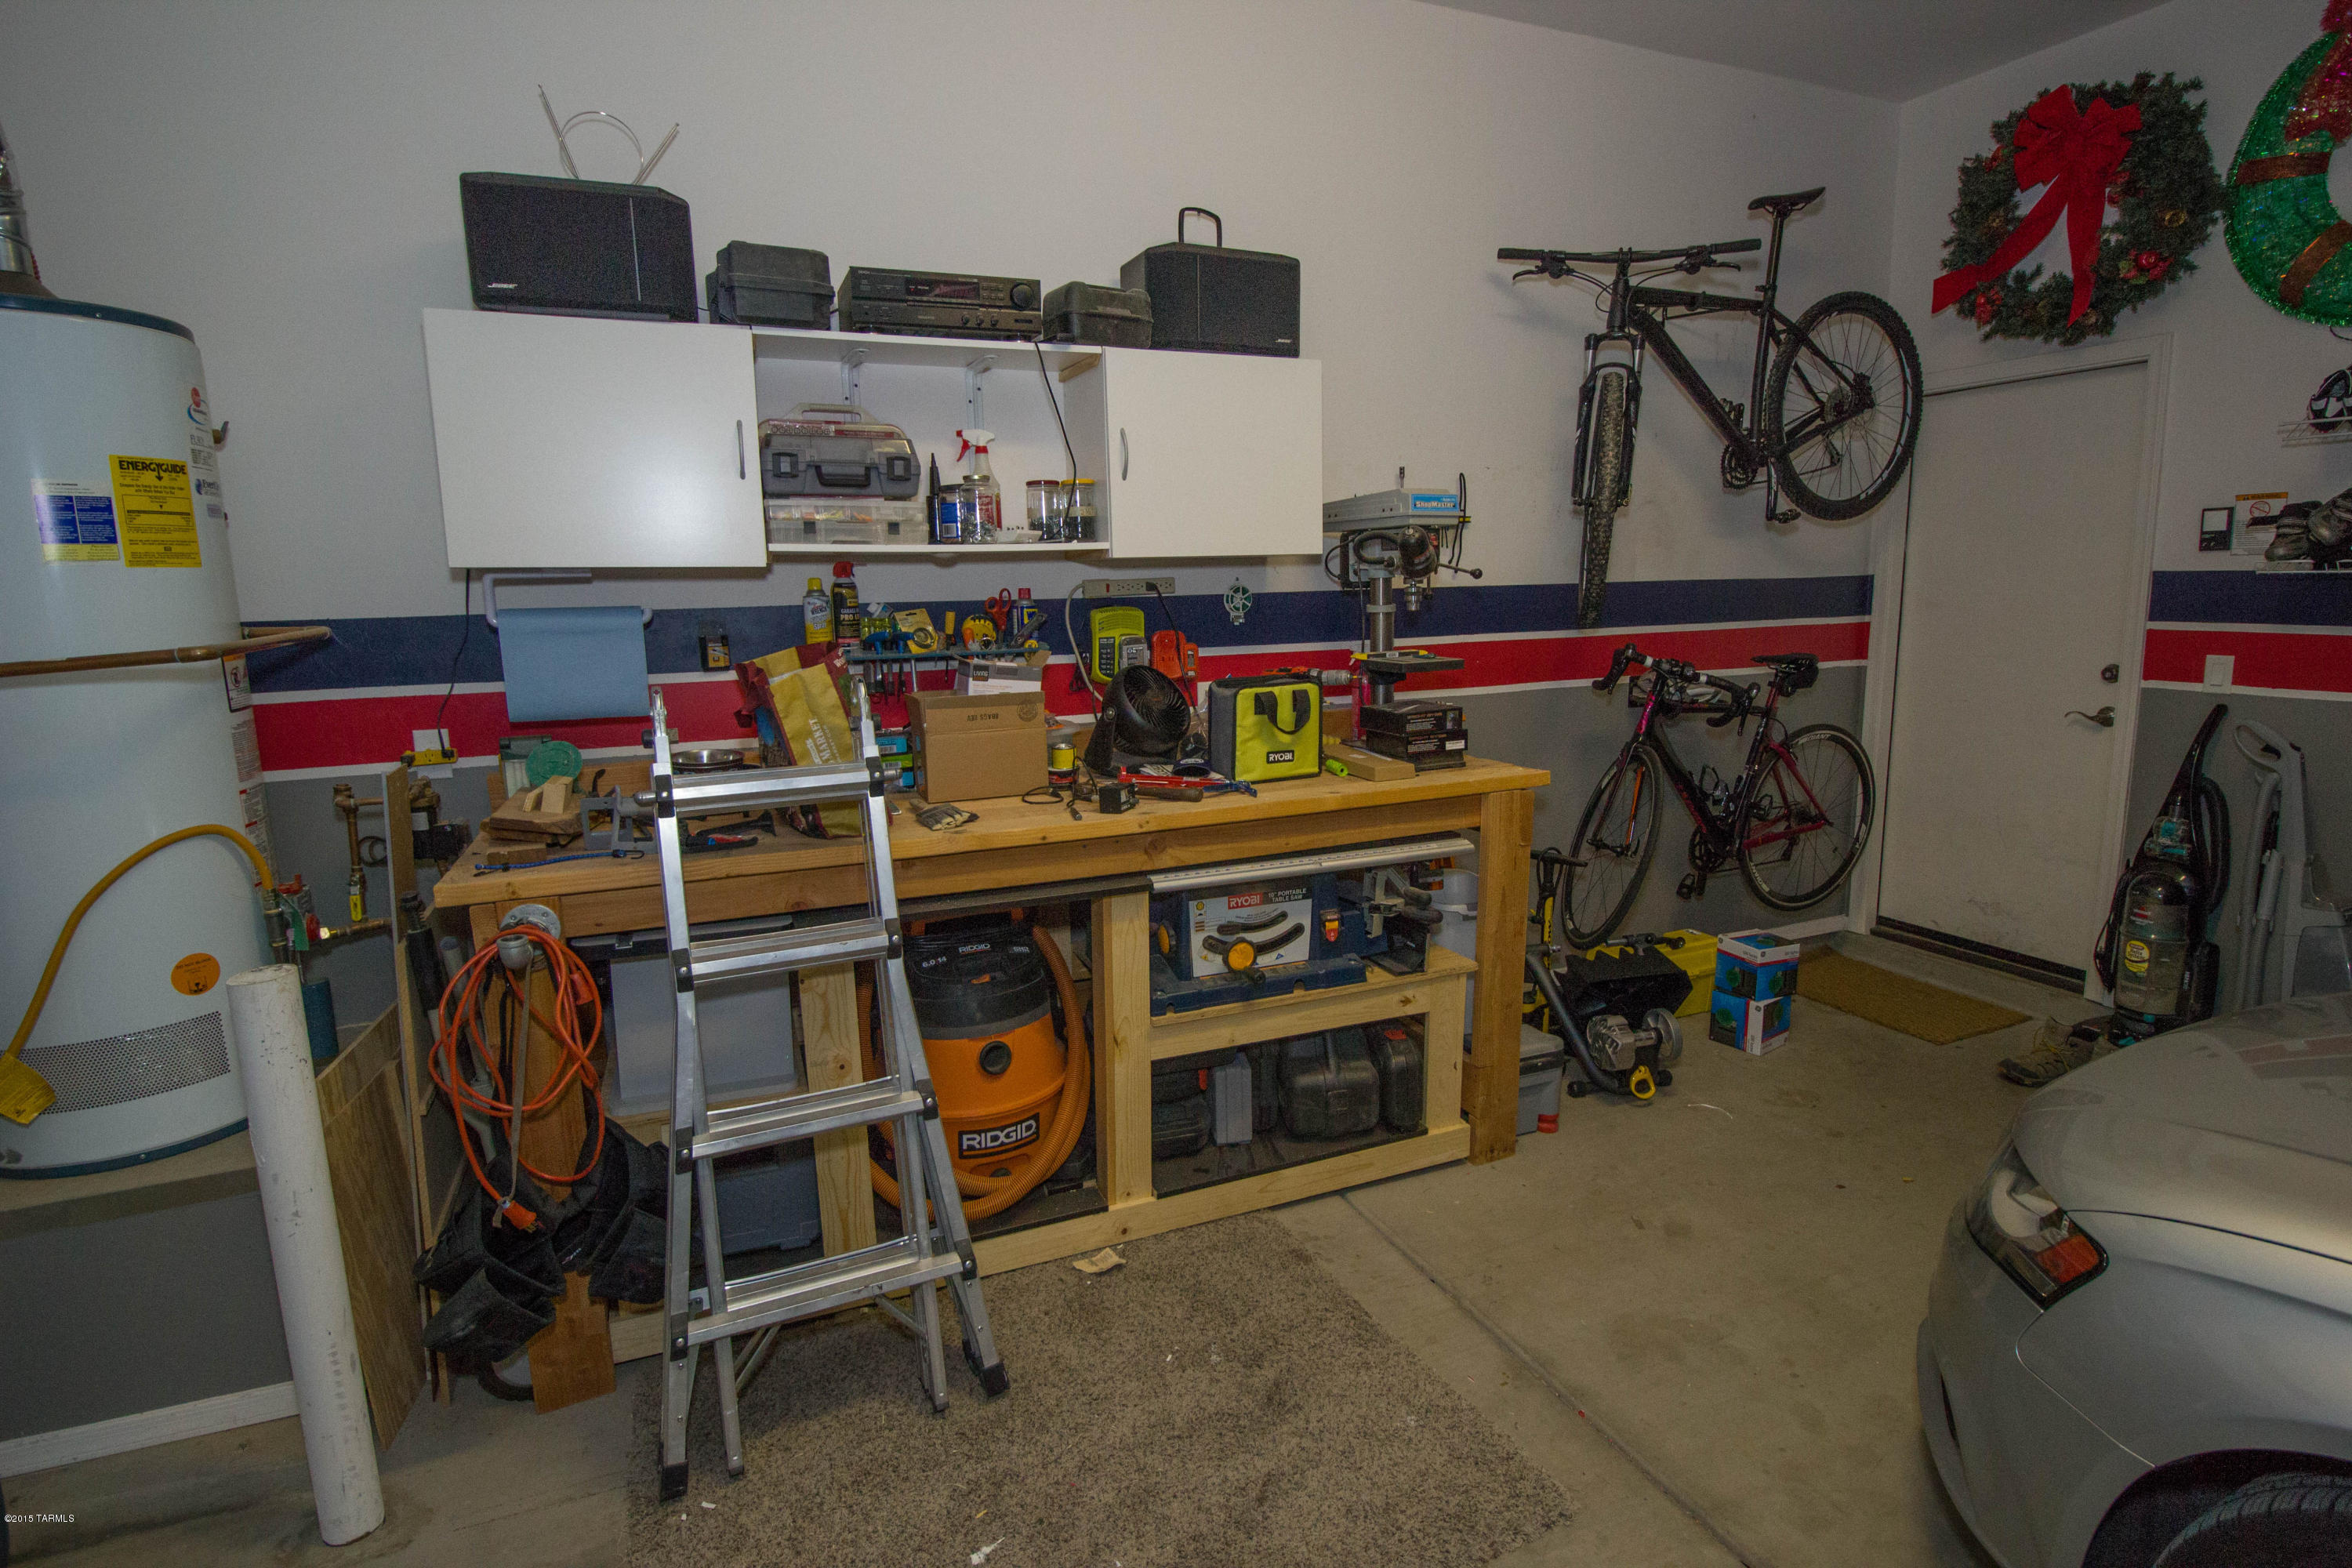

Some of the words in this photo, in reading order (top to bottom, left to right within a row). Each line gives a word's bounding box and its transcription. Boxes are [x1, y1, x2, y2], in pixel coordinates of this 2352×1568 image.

[118, 460, 187, 474] ENERGYGUIDE
[1269, 752, 1293, 763] RYOBI
[1278, 887, 1307, 897] PORTABLE
[1229, 895, 1261, 908] RYOBI
[958, 943, 991, 953] RIDGID
[962, 1120, 1036, 1151] RIDGID
